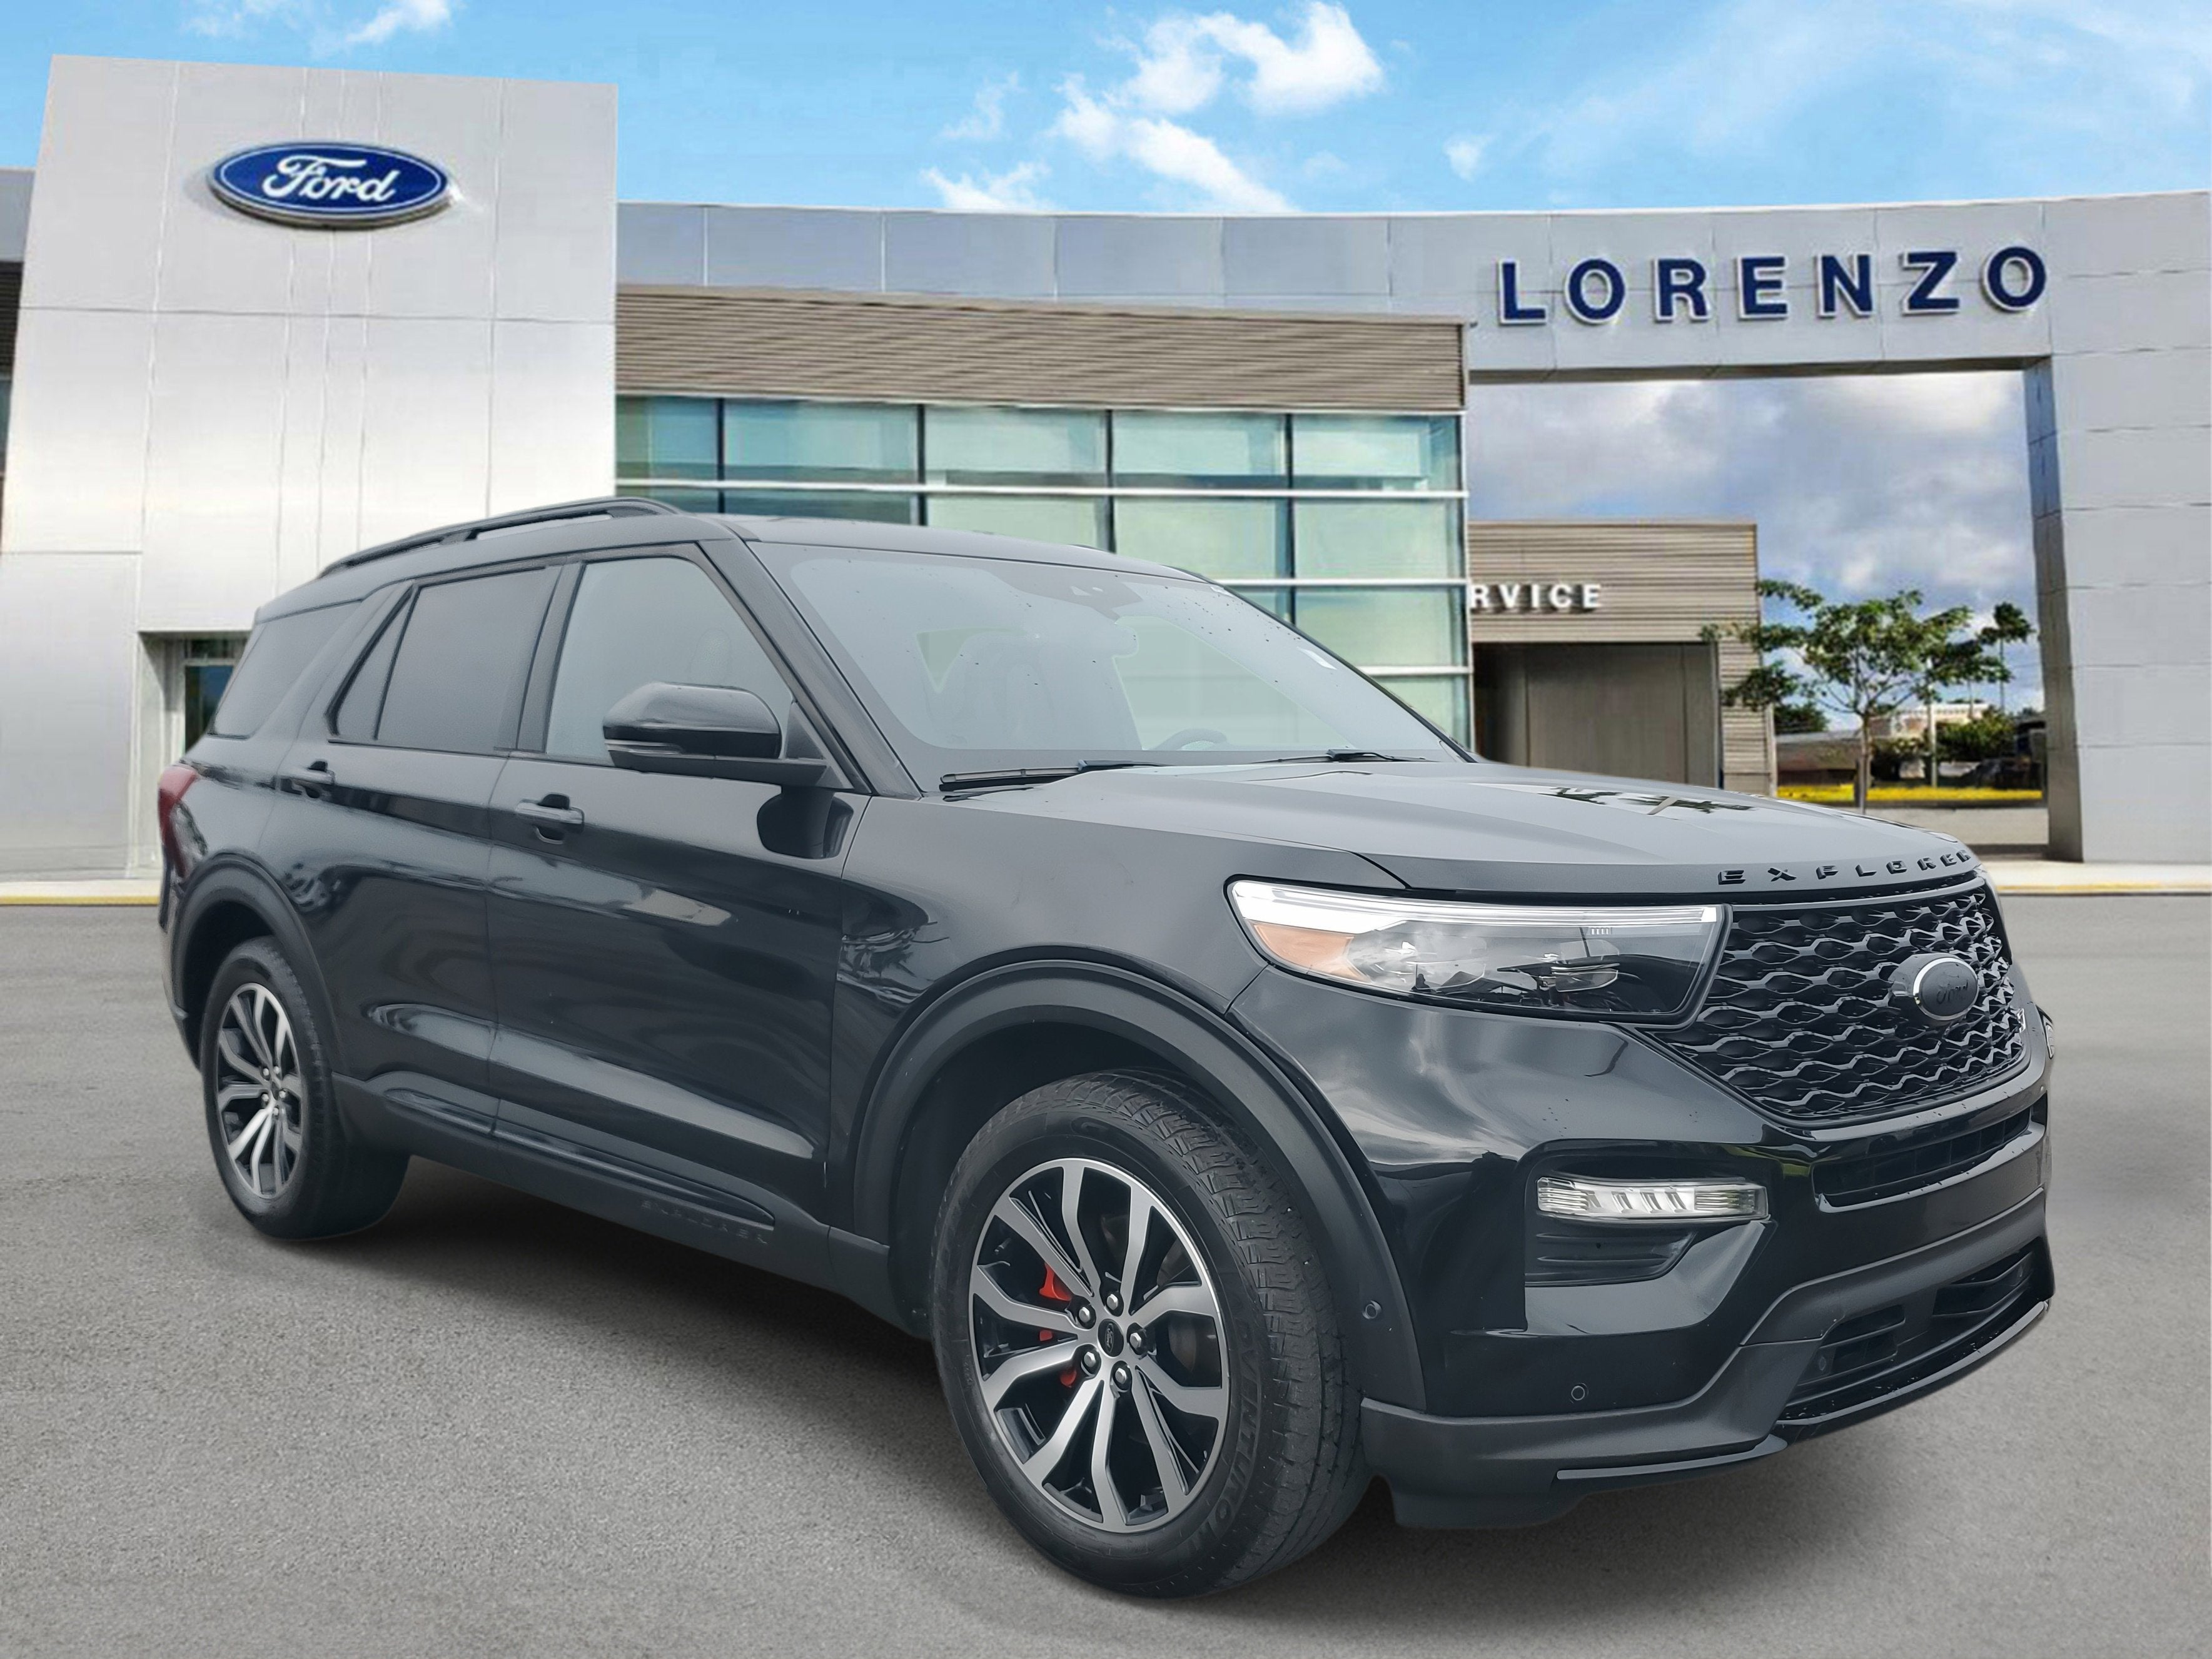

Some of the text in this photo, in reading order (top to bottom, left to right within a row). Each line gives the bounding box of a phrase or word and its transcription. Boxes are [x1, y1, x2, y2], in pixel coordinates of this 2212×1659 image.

[262, 154, 400, 202] Ford
[1499, 246, 2048, 326] LORENZO
[1717, 849, 1972, 885] EXPLORER
